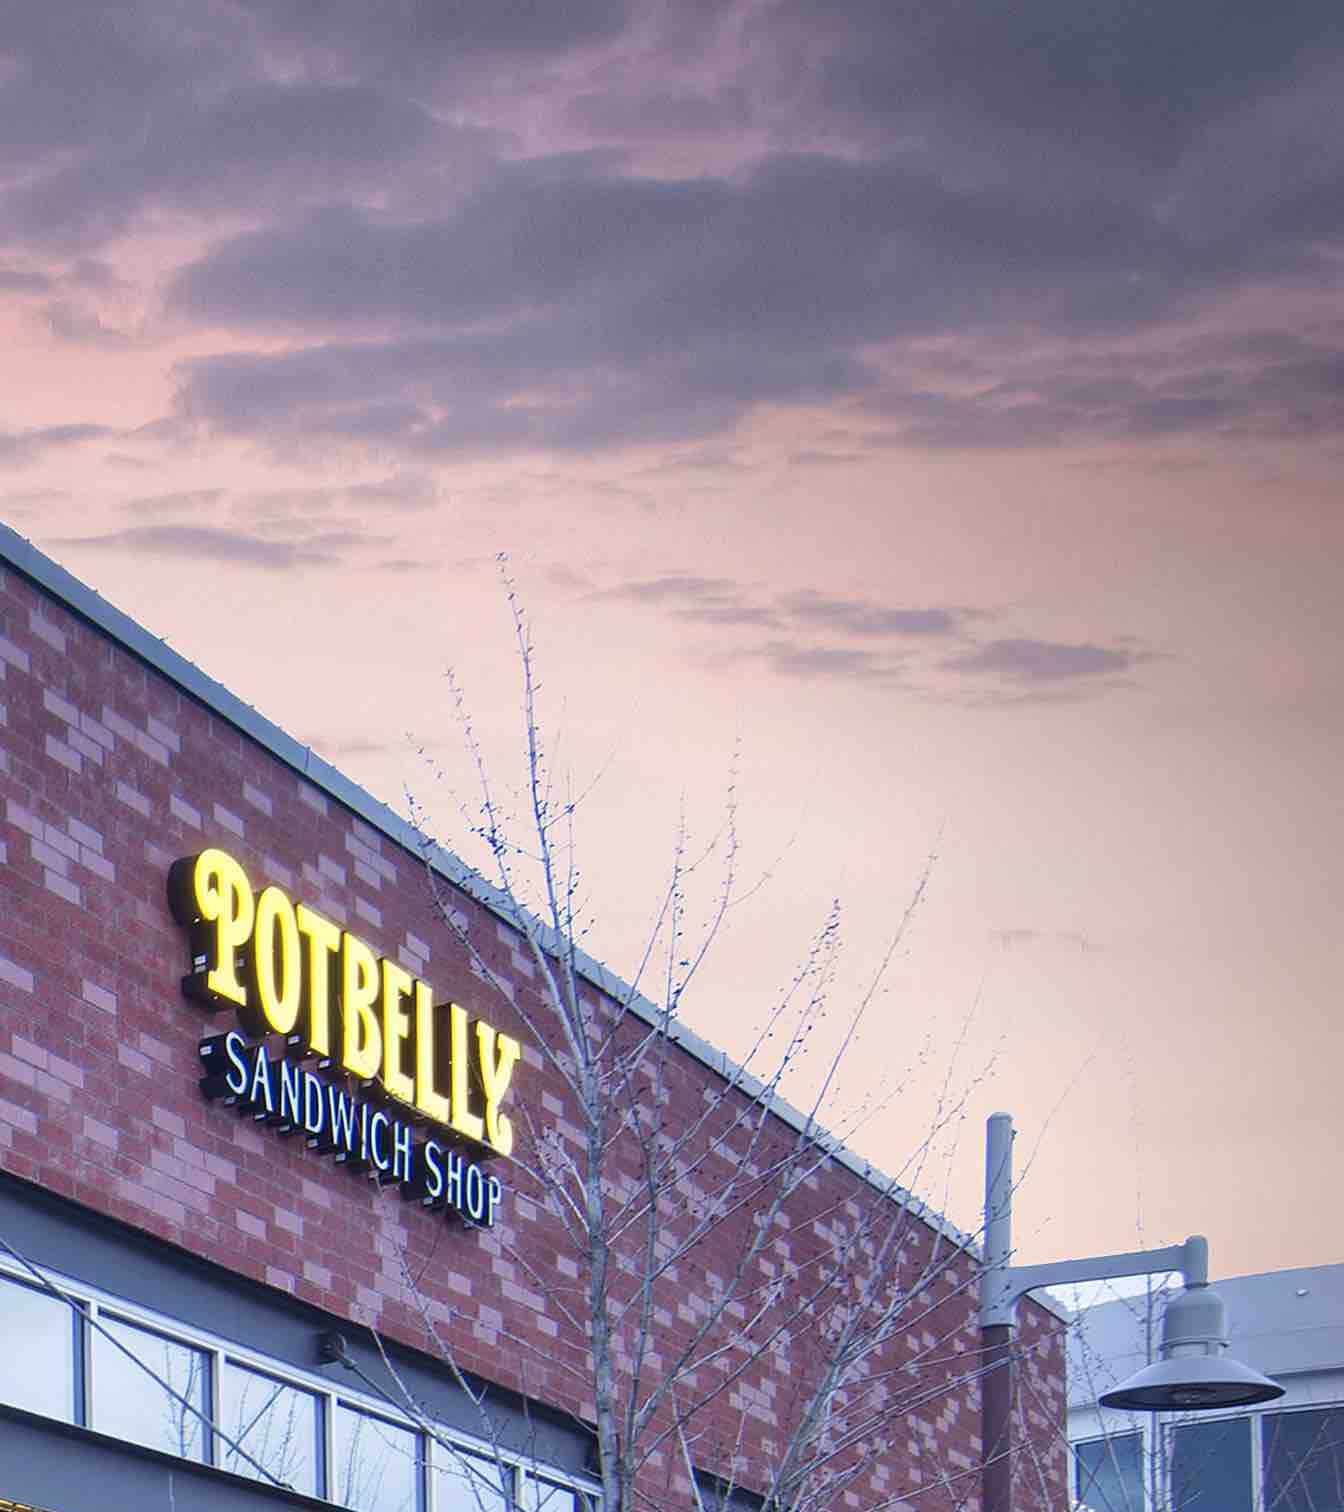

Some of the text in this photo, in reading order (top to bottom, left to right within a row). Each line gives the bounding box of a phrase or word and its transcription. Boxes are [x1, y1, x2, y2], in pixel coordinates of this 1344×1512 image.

[193, 847, 521, 1157] POTBELLY
[224, 1030, 504, 1229] SANDWICH SHOP
